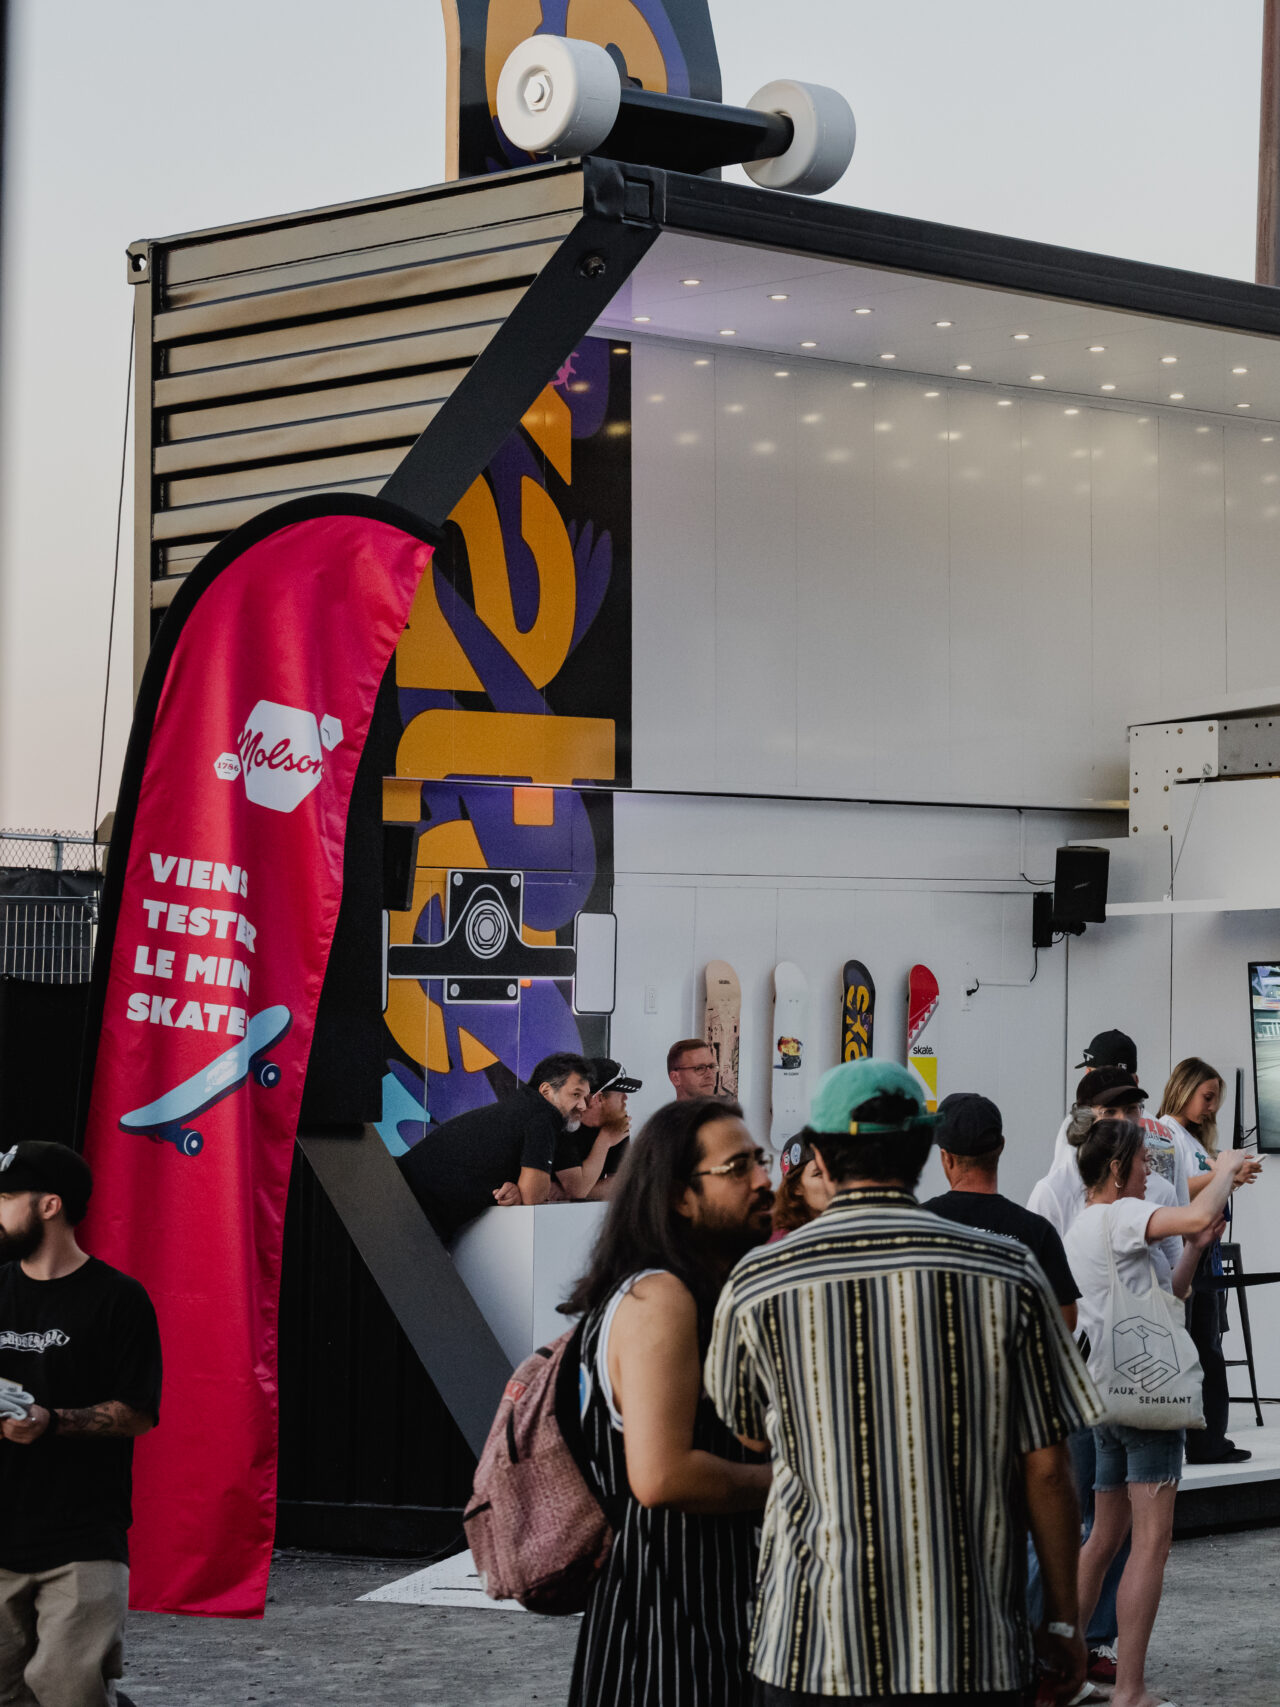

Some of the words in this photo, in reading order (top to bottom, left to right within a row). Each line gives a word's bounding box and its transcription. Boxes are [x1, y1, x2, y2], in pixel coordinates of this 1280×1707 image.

[217, 761, 239, 772] 1786
[239, 728, 325, 776] Molson
[149, 852, 249, 899] VIENS
[142, 898, 257, 953] TESTER
[133, 945, 176, 979] LE
[184, 953, 251, 997] MIN
[126, 992, 250, 1038] SKATE
[1139, 1396, 1192, 1404] SEMBLANT
